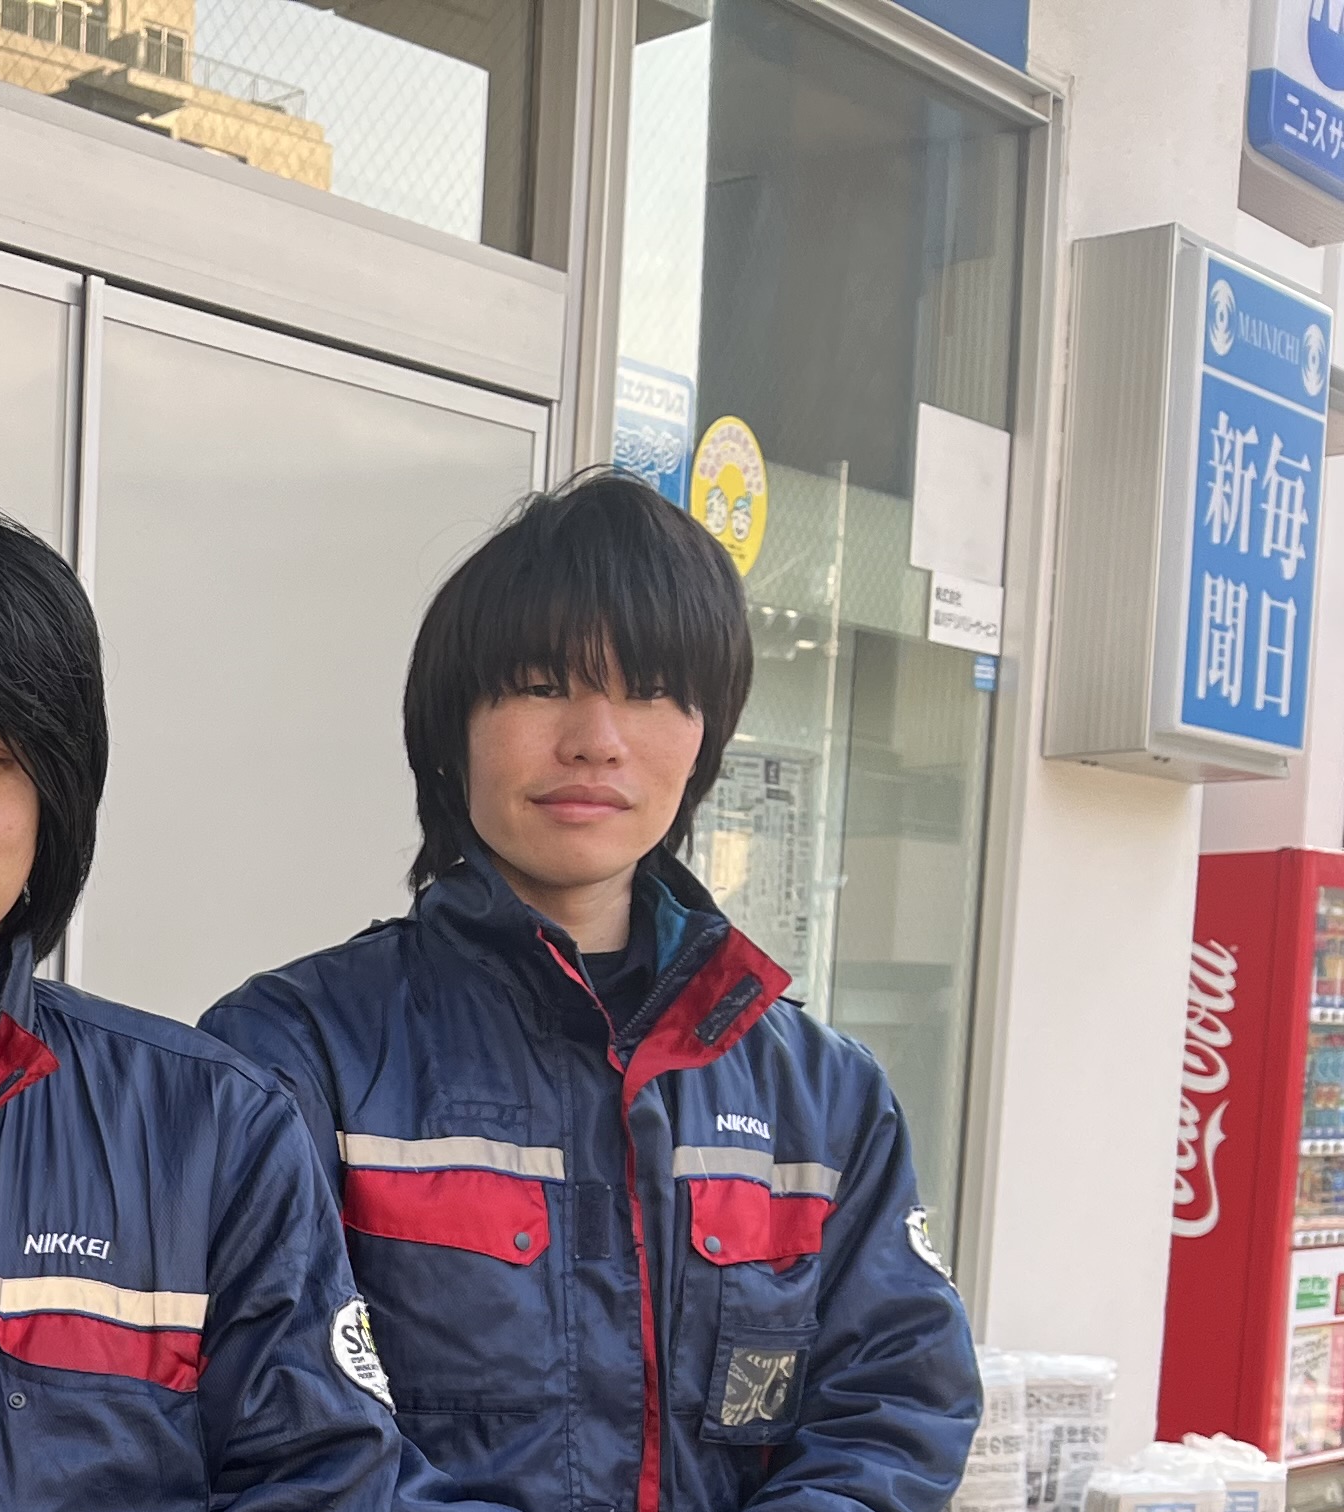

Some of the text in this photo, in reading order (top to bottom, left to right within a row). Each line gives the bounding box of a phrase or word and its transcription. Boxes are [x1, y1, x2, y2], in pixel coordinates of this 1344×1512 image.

[1238, 311, 1301, 365] MAINICHI
[1197, 410, 1259, 706] 新聞
[1254, 431, 1311, 717] 毎日
[23, 1232, 111, 1260] NIKKEI
